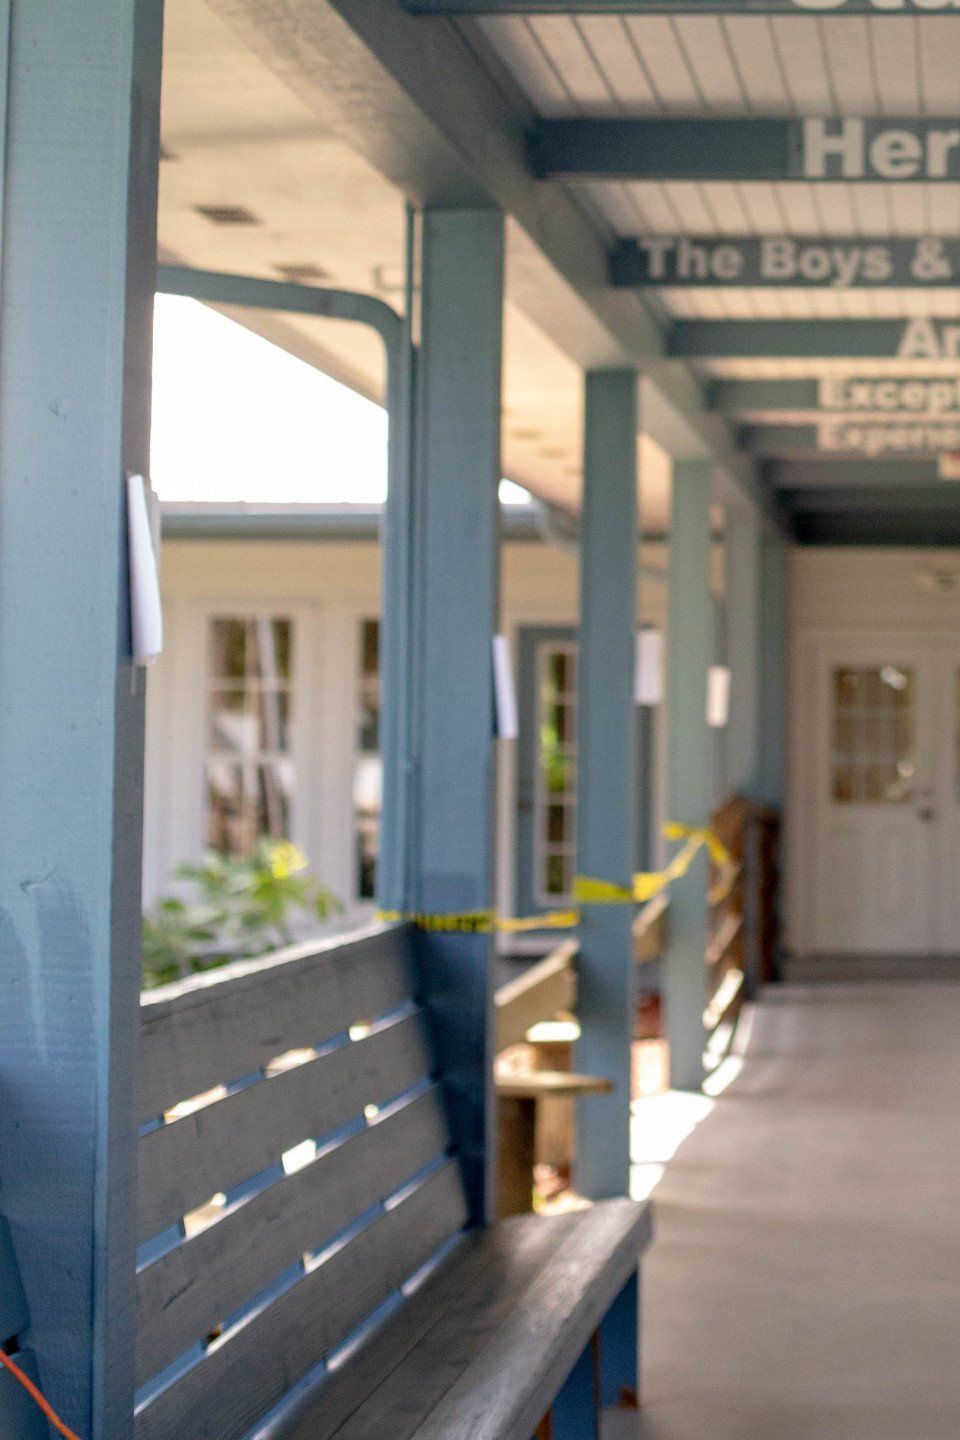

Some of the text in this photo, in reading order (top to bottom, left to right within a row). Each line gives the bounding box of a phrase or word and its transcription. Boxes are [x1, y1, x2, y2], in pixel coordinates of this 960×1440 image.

[637, 238, 744, 279] The
[760, 239, 893, 287] Boys
[911, 239, 952, 280] &
